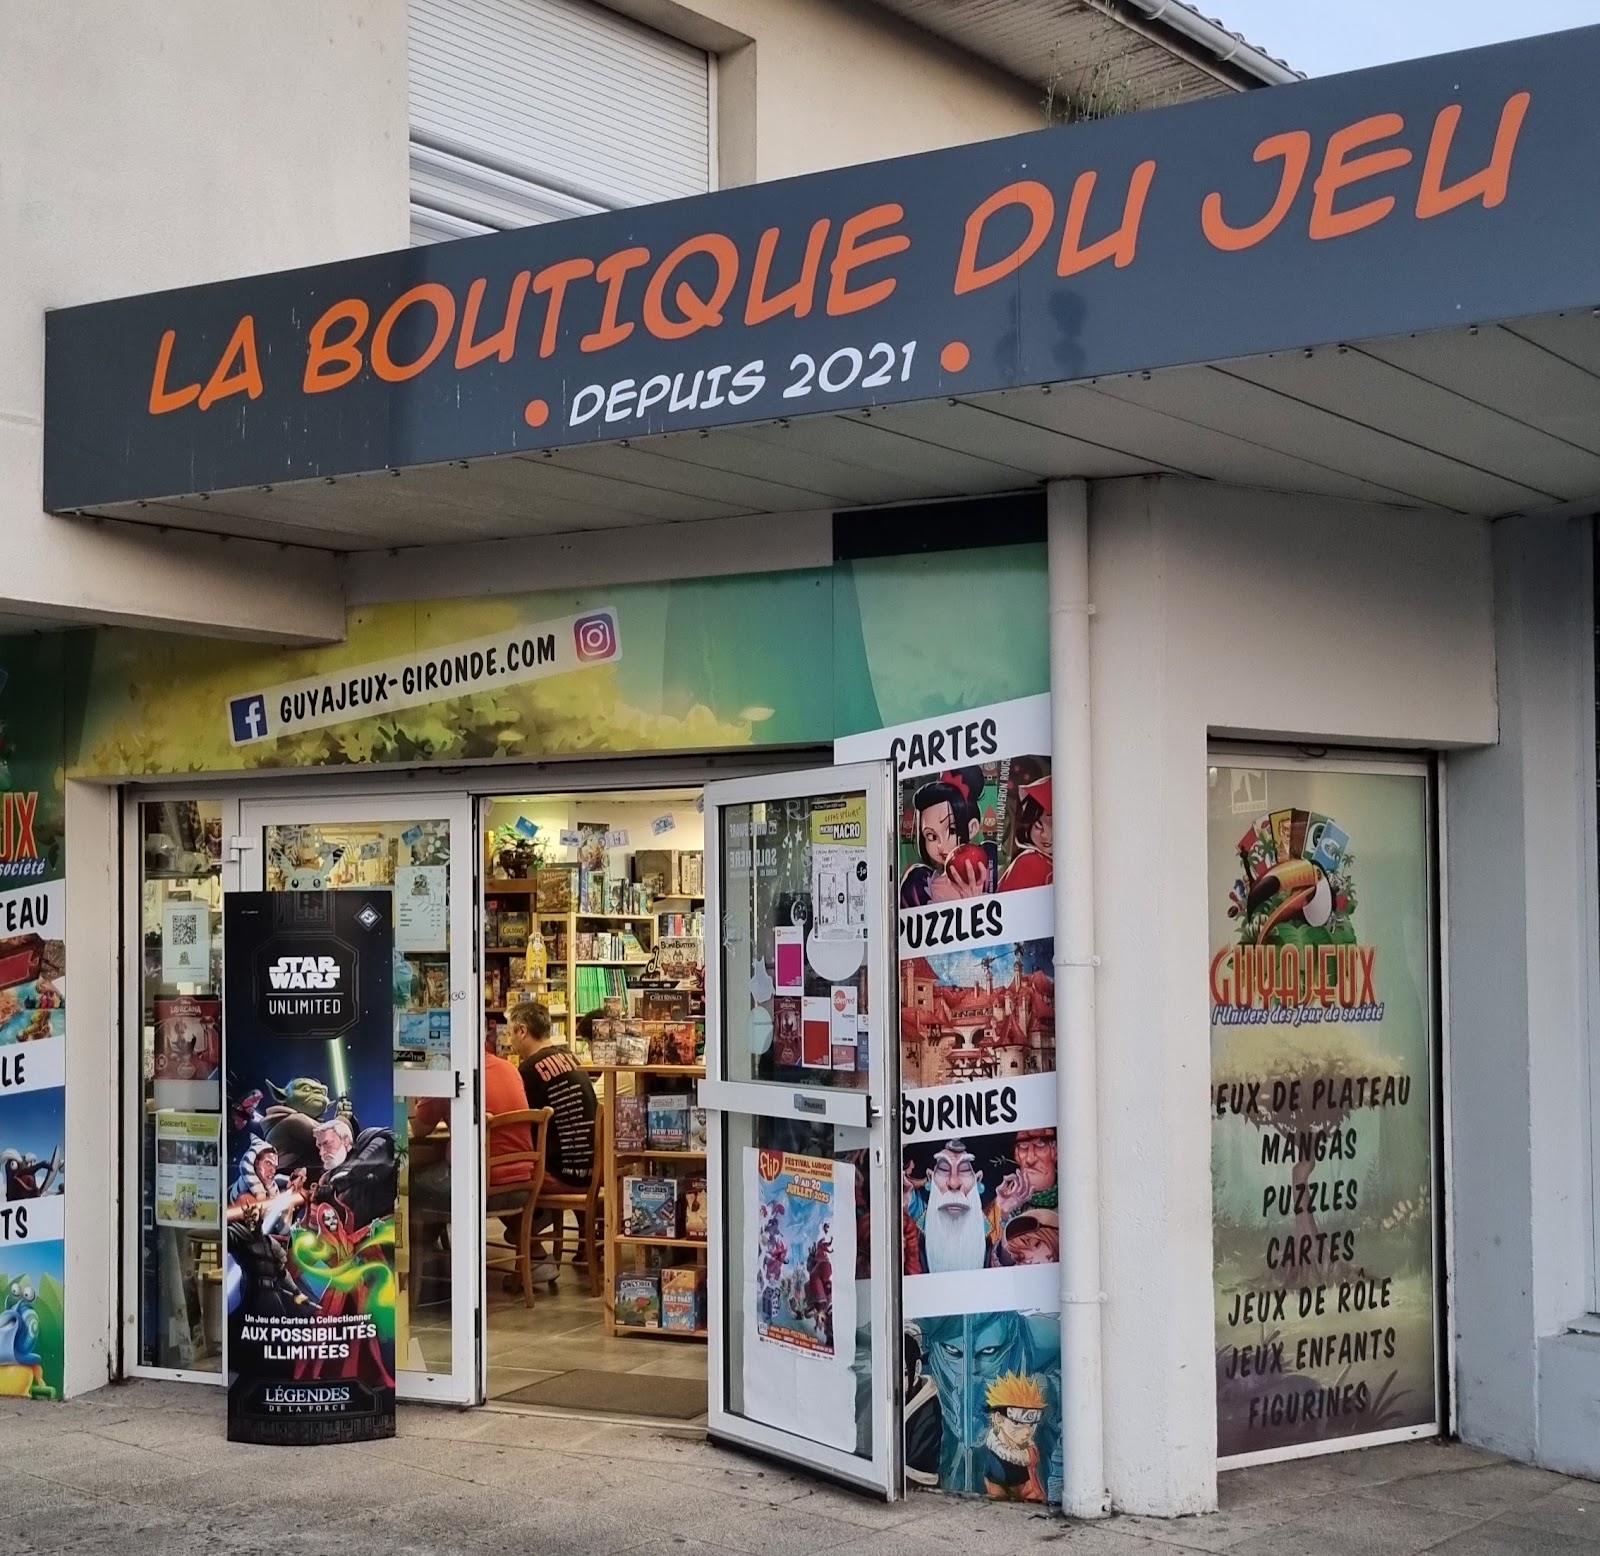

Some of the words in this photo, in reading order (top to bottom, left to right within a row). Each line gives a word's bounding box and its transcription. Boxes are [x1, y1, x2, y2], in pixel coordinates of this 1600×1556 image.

[149, 314, 263, 415] LA
[302, 203, 910, 394] BOUTIQUE
[954, 160, 1156, 295] DU
[1201, 91, 1531, 251] JEU
[569, 359, 766, 428] DEPUIS
[781, 340, 918, 400] 2021
[279, 633, 557, 724] GUYAJEUX-GIRONDE.COM
[998, 782, 1009, 821] CHAPERON
[833, 822, 860, 839] MACRO
[899, 900, 1004, 949] UZZLES
[269, 956, 340, 973] STAR
[269, 972, 340, 989] WARS
[1209, 943, 1378, 1010] GUYAJEUX
[269, 999, 341, 1015] UNLIMITED
[1270, 1005, 1293, 1023] des
[1324, 1005, 1340, 1021] de
[1342, 1001, 1384, 1021] société
[1211, 1082, 1260, 1115] EUX
[1273, 1080, 1301, 1111] DE
[1313, 1075, 1411, 1111] PLATEAU
[1261, 1127, 1357, 1165] MANGAS
[785, 1157, 811, 1168] FESTIVAL
[811, 1161, 833, 1171] LUDIQUE
[637, 1183, 668, 1193] Genius
[787, 1183, 813, 1199] JUILLET
[814, 1190, 830, 1203] 2025
[794, 1174, 800, 1185] 9
[811, 1179, 821, 1191] 20
[1262, 1178, 1358, 1218] PUZZLES
[1266, 1230, 1354, 1270] CARTES
[1228, 1289, 1287, 1327] JEUX
[1299, 1284, 1326, 1318] DE
[1338, 1271, 1392, 1314] RÔLE
[245, 1314, 254, 1322] Un
[255, 1315, 269, 1324] Jeu
[270, 1316, 280, 1324] de
[281, 1316, 308, 1325] Cartes
[310, 1315, 316, 1324] à
[316, 1314, 372, 1324] Collectionner
[241, 1326, 269, 1342] AUX
[271, 1323, 377, 1342] POSSIBILITÉS
[264, 1343, 350, 1360] ILLIMITÉES
[1225, 1341, 1284, 1380] JEUX
[1296, 1327, 1395, 1371] ENFANTS
[265, 1385, 350, 1403] LÉGENDES
[309, 1403, 346, 1412] FORCE
[1248, 1382, 1367, 1429] FIGURINES
